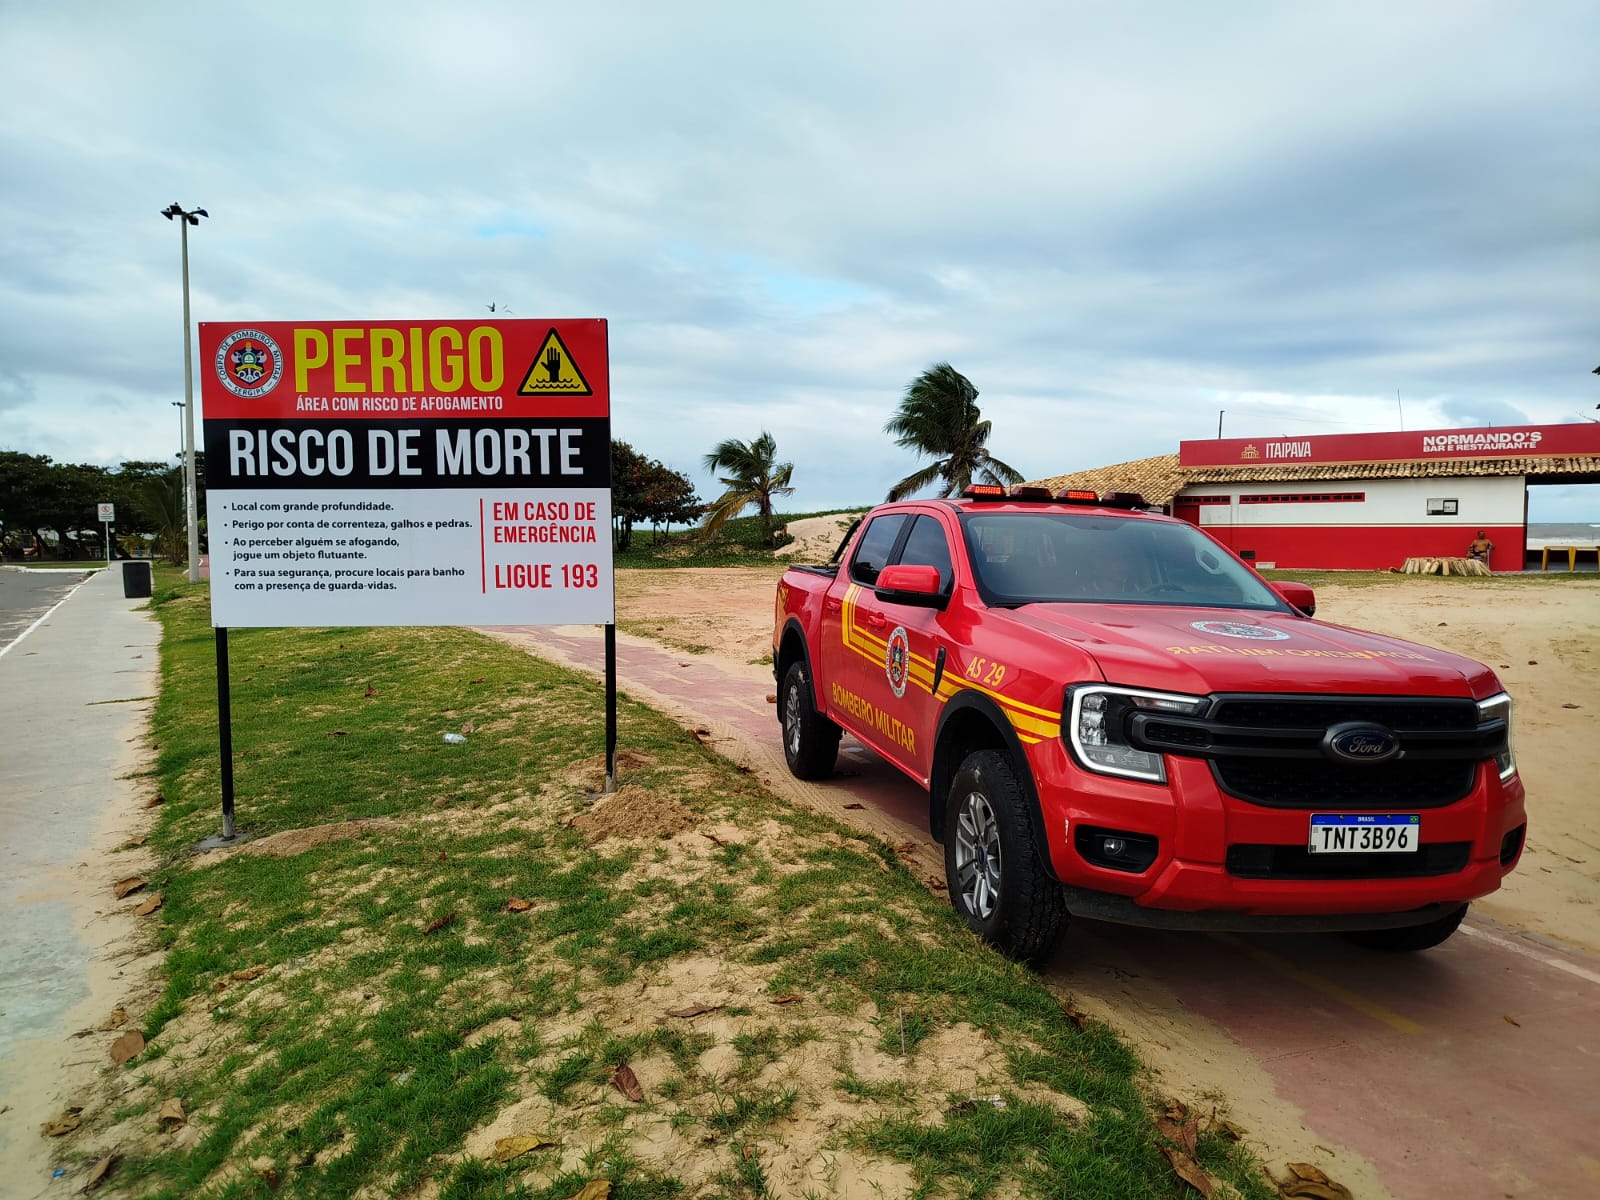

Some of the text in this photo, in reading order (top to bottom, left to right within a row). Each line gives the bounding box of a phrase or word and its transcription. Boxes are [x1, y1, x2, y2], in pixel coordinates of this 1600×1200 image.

[217, 331, 281, 381] CORPO DE BOMBEIROS MILITAR
[293, 326, 505, 394] PERIGO
[234, 387, 265, 395] SERGIPE
[296, 395, 503, 412] ÁREA COM RISCO DE AFOGAMENTO
[1422, 431, 1543, 446] NORMANDO'S
[1423, 441, 1538, 452] BAR E RESTAURANTE
[228, 428, 584, 477] RISCO DE MORTE
[1265, 441, 1312, 458] ITAIPAVA
[231, 502, 394, 513] Local com grande profundidade.
[493, 501, 596, 521] EM CASO DE
[232, 520, 264, 531] Perigo
[266, 521, 284, 531] por
[286, 520, 315, 529] conta
[316, 520, 330, 529] de
[331, 520, 388, 530] correnteza,
[390, 519, 425, 531] galhos
[435, 518, 473, 530] pedras.
[493, 523, 597, 543] EMERGÊNCIA
[233, 537, 400, 548] Ao perceber alguém se afogando,
[232, 550, 262, 561] jogue
[282, 550, 316, 561] objeto
[318, 549, 367, 559] flutuante.
[234, 567, 465, 579] Para sua segurança, procure locais para banho
[494, 563, 598, 589] LIGUE 193
[265, 582, 311, 592] presença
[313, 581, 326, 590] de
[328, 580, 397, 592] guarda-vidas.
[966, 655, 1006, 687] AS 29
[832, 682, 917, 757] BOMBEIRO MILITAR
[1348, 736, 1385, 753] Ford
[1322, 826, 1408, 850] TNT3B96
